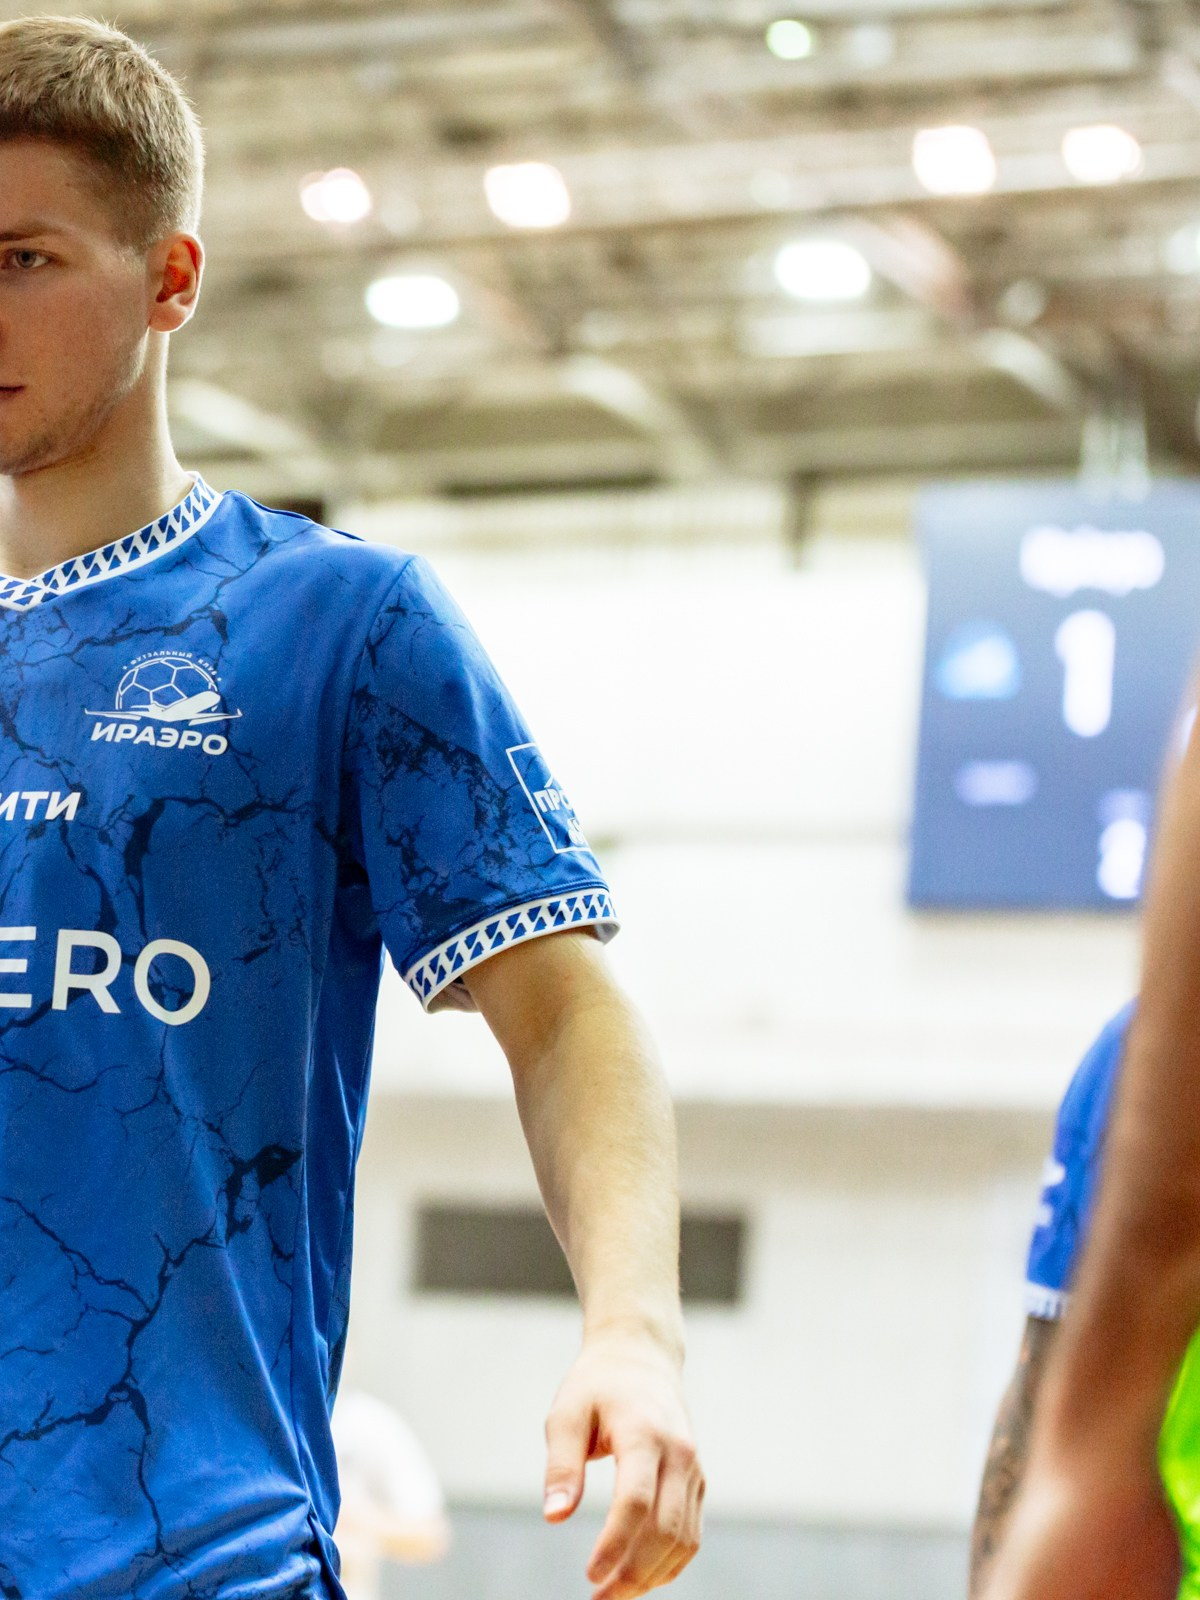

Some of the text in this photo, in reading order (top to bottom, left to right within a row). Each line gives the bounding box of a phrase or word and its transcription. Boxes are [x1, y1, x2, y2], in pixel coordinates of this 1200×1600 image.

[130, 650, 218, 676] ФУТЗАЛЬНЫЙ КЛУБ
[90, 721, 228, 756] ИРАЭРО
